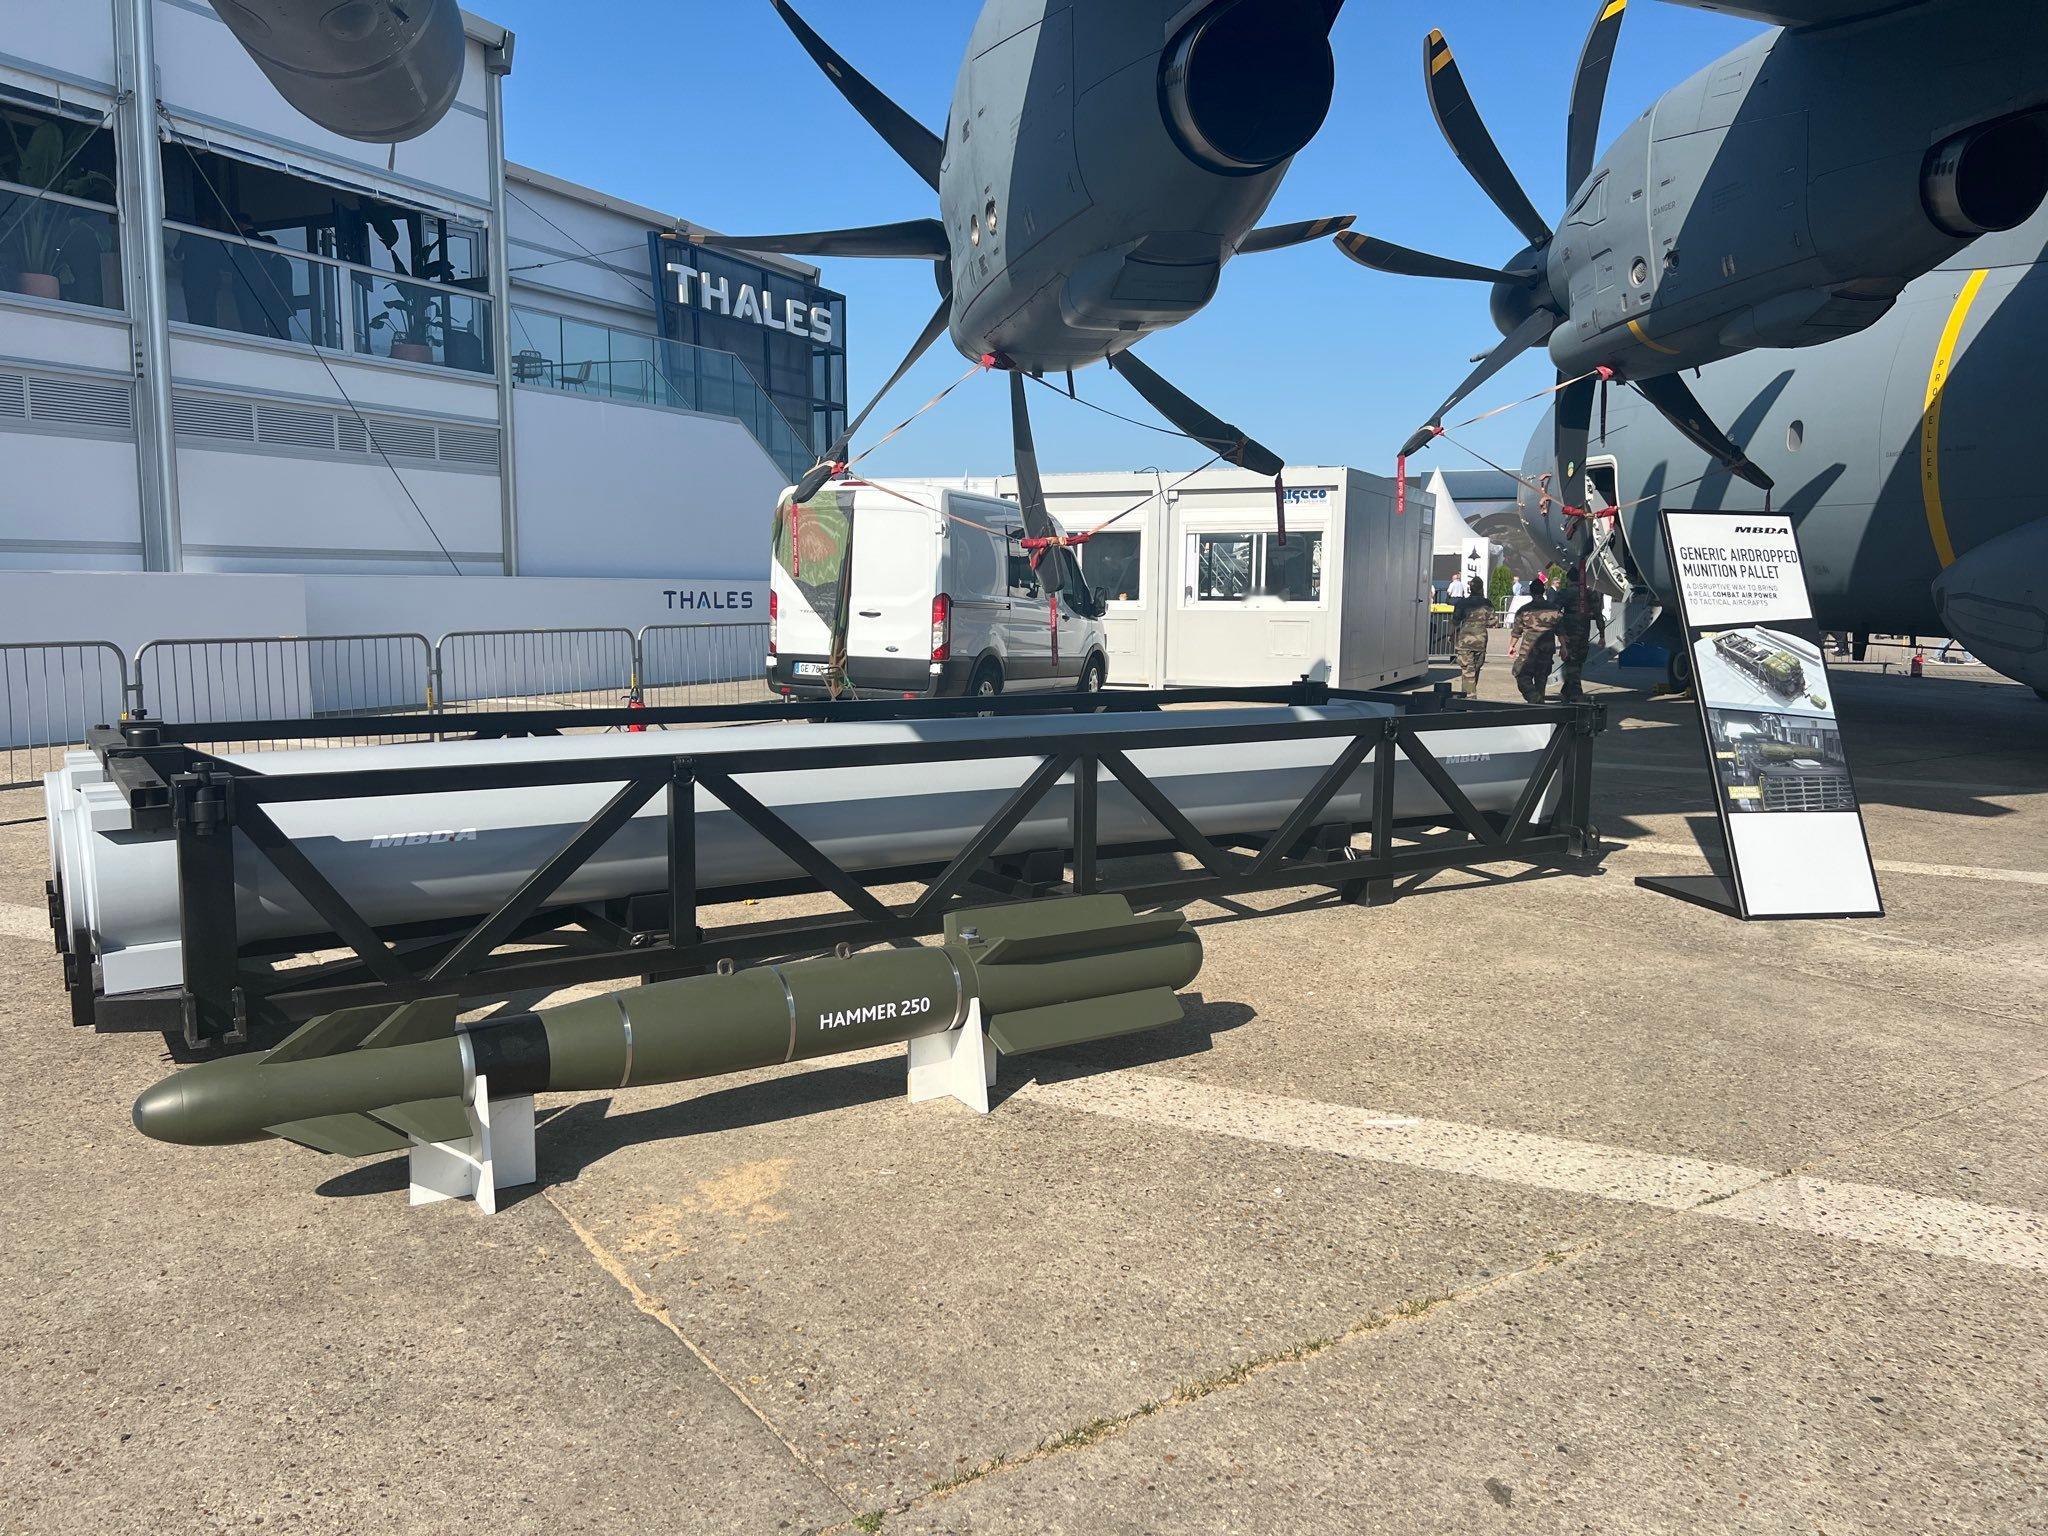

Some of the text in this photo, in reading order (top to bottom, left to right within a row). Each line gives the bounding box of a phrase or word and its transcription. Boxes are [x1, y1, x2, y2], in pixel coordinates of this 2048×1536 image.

[666, 262, 832, 343] THALES
[1926, 359, 1944, 480] PROPELLER
[1735, 526, 1788, 535] MBDA
[1680, 547, 1798, 564] GENERIC AIRDROPPED
[1683, 563, 1779, 579] MUNITION PALLET
[663, 590, 753, 609] THALES
[1732, 599, 1769, 607] AIRCRAFTS
[800, 664, 809, 673] GE
[1445, 752, 1491, 764] MBDA
[369, 828, 477, 849] MBDA
[820, 996, 931, 1030] HAMMER 250
